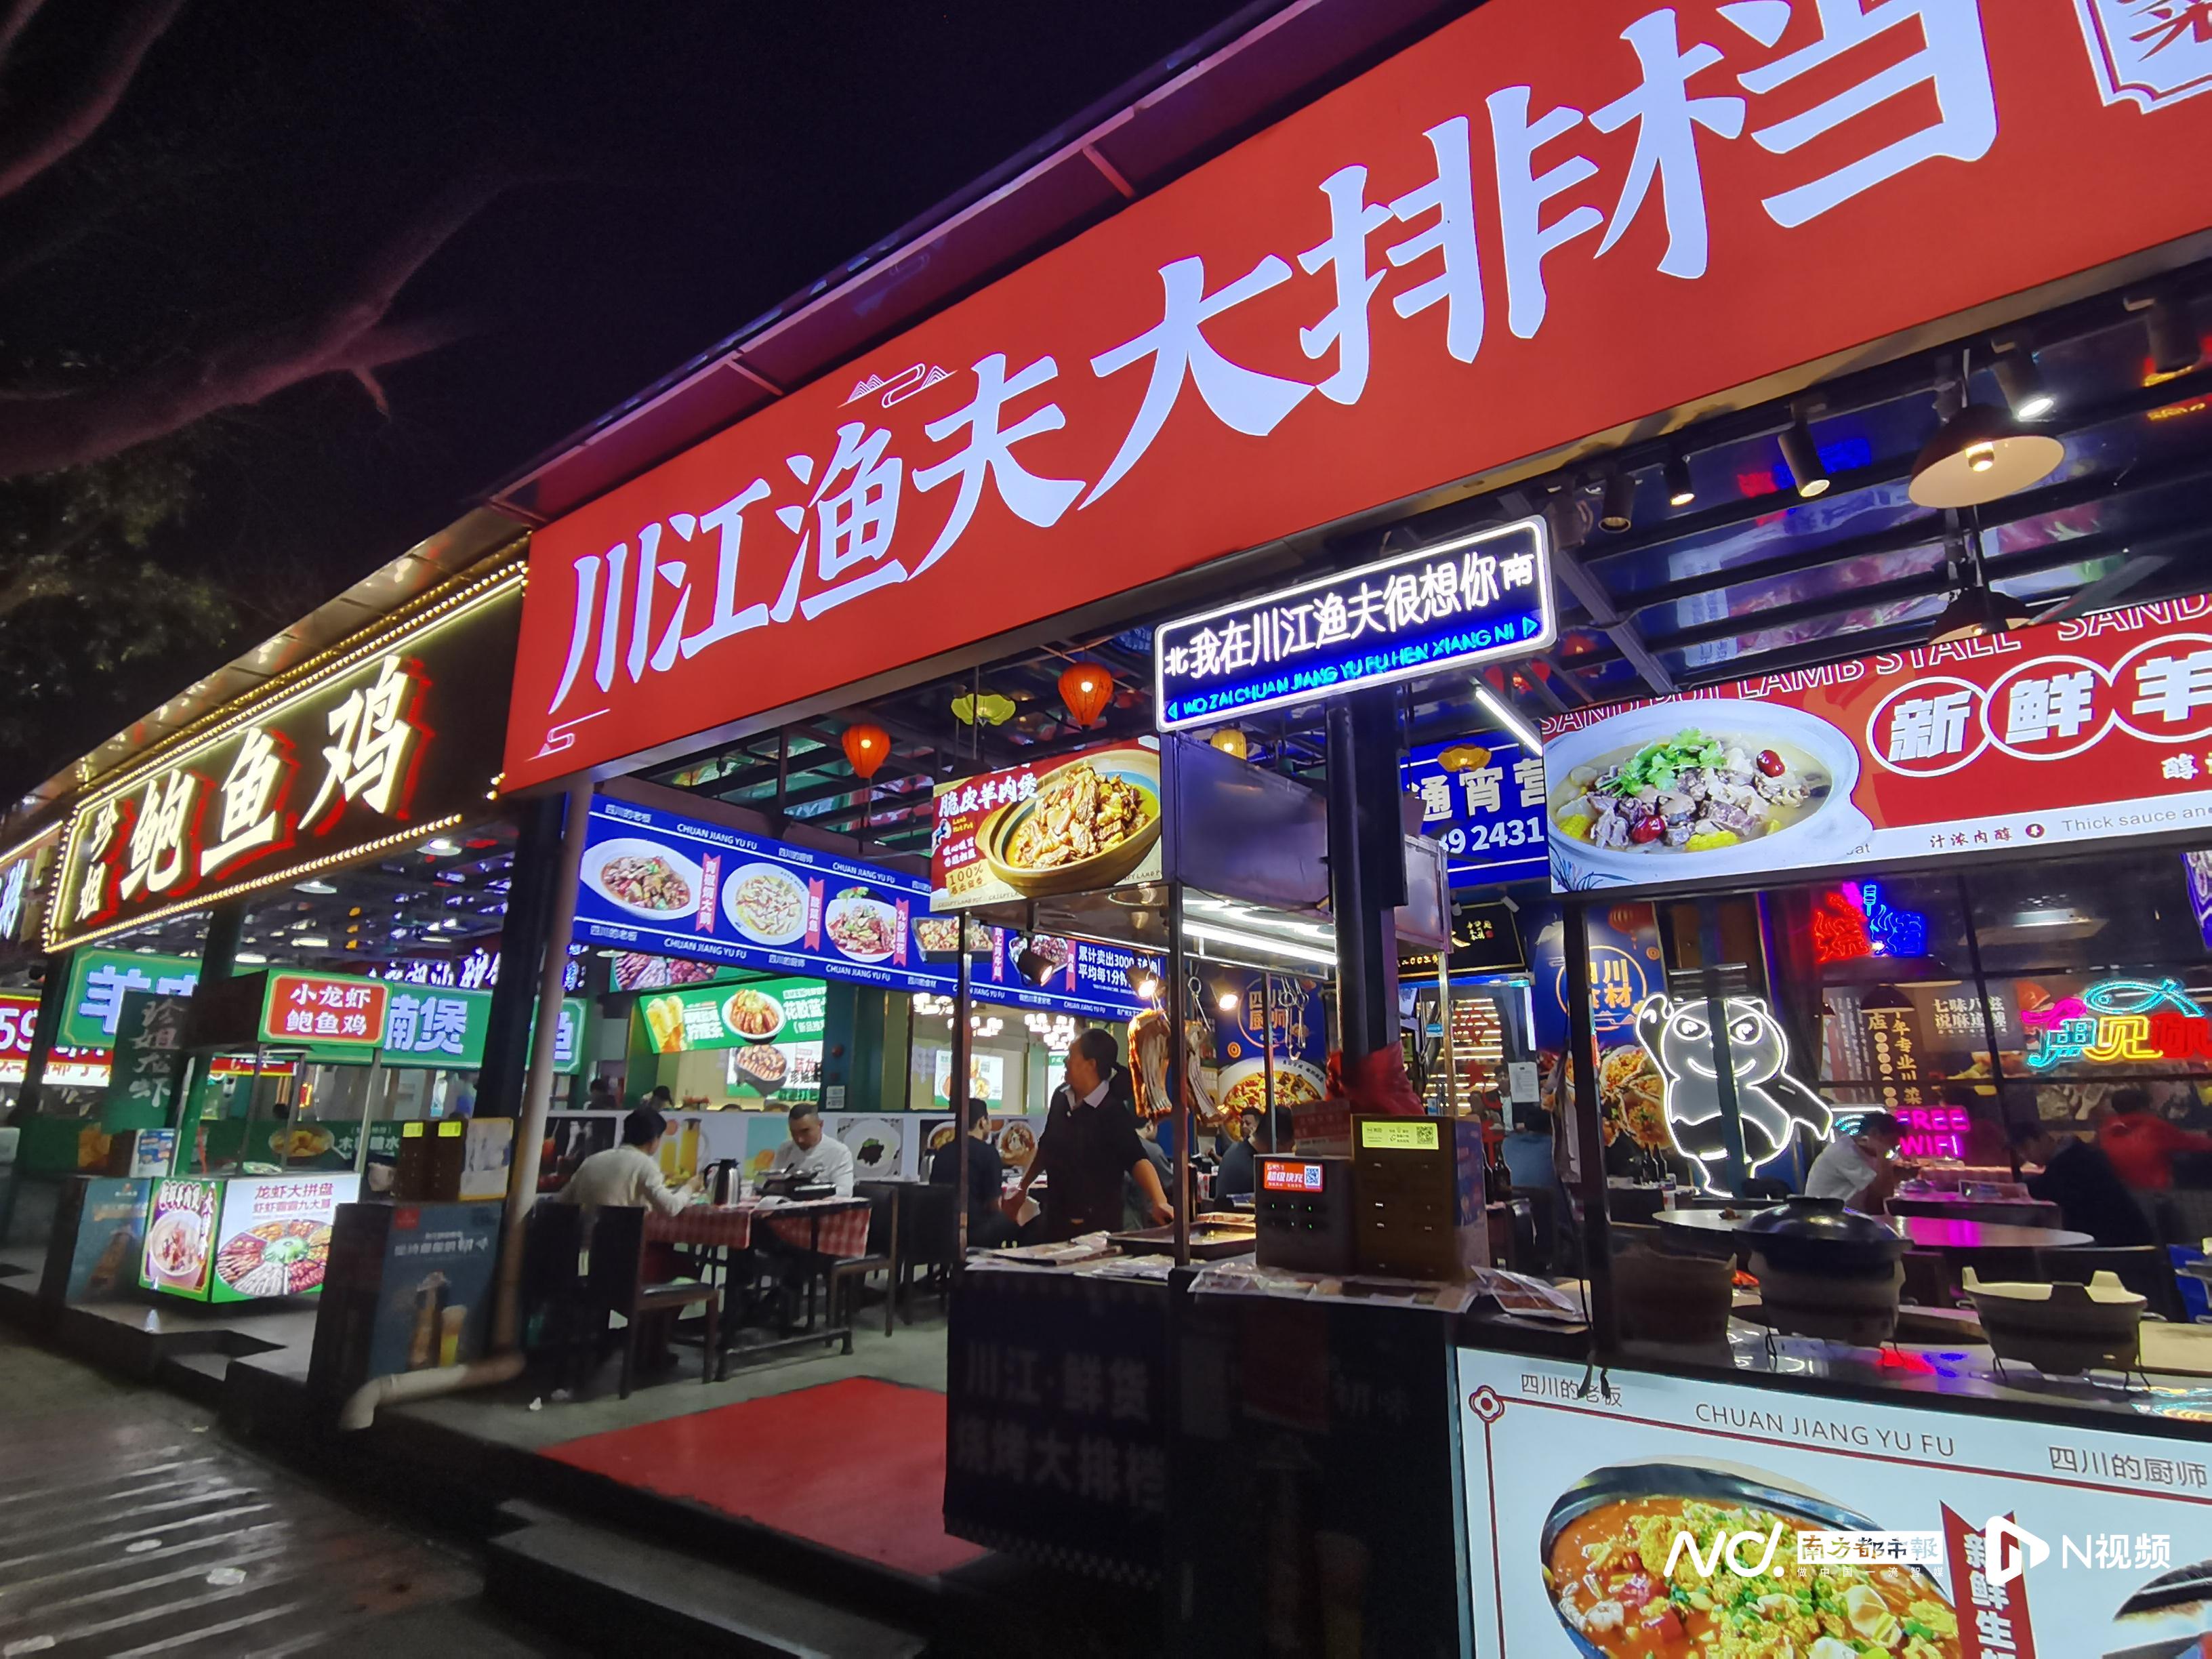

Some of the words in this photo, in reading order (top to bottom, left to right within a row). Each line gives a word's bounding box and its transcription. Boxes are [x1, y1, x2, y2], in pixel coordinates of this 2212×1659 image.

[548, 0, 1999, 714] 川江渔夫大排档
[1183, 695, 1208, 716] WO
[1209, 688, 1234, 710] ZAI
[1235, 678, 1288, 703] CHUAN
[1291, 665, 1338, 693] JIANG
[1340, 658, 1363, 680] YU
[1364, 650, 1392, 675] FU
[1393, 641, 1429, 665] HEN
[1431, 629, 1492, 659] XIANG
[1494, 620, 1515, 642] NI
[1887, 649, 2212, 763] 新鲜羊
[120, 655, 413, 900] 鲍鱼鸡
[939, 772, 1040, 817] 脆皮羊肉煲
[676, 823, 709, 839] CHUAN
[1470, 817, 1544, 851] 2431
[1929, 826, 2013, 849] 汁浓肉醇
[2062, 816, 2114, 835] Thick
[2118, 809, 2177, 827] sauce
[289, 983, 371, 1010] 小龙虾
[285, 1008, 367, 1036] 鲍鱼鸡
[1895, 1109, 1969, 1132] FREE
[1899, 1133, 1964, 1157] WIFI
[255, 1182, 334, 1200] 龙虾大拼盘
[1695, 1401, 1784, 1435] CHUAN
[1789, 1417, 1870, 1448] JIANG
[1874, 1429, 1912, 1452] YU
[1919, 1434, 1955, 1458] FU
[2047, 1445, 2208, 1490] 四川的厨师
